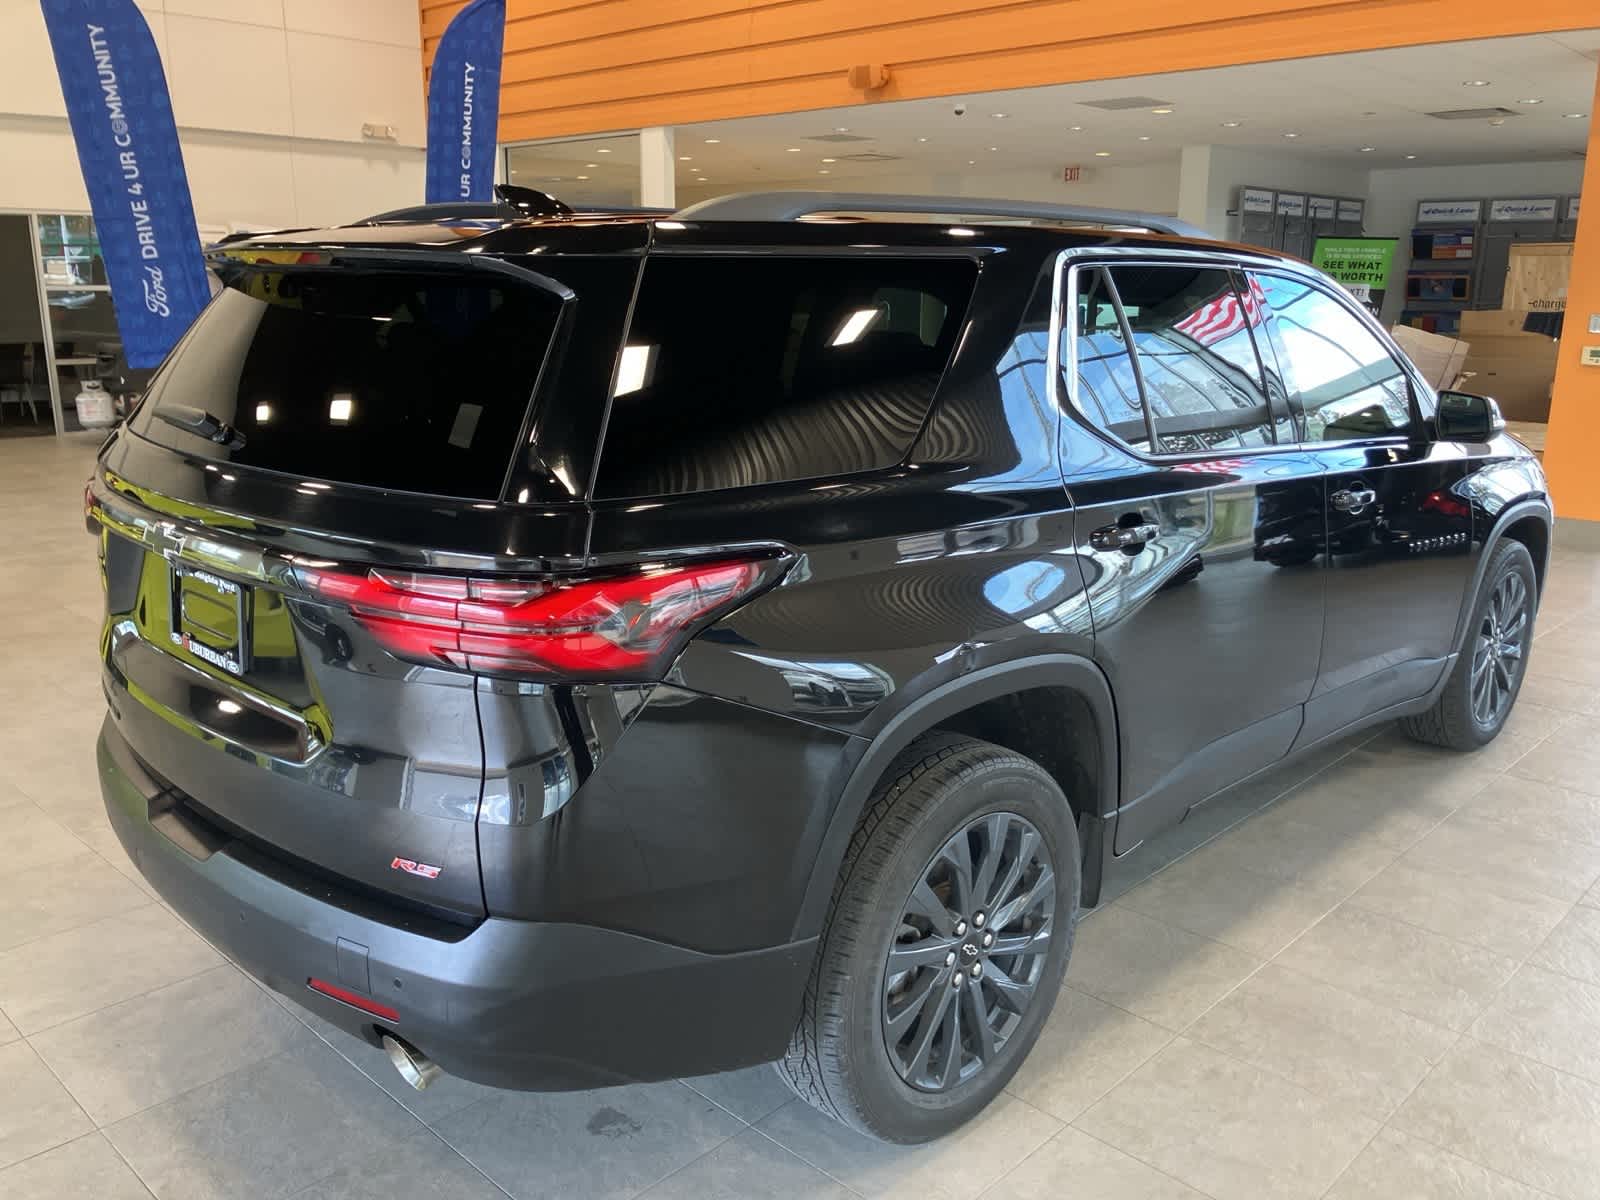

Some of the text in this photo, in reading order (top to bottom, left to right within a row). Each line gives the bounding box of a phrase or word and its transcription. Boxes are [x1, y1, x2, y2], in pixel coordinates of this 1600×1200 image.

[119, 151, 140, 180] UR
[1064, 167, 1081, 182] EXIT
[127, 182, 144, 196] 4
[460, 173, 471, 198] UR
[131, 199, 159, 259] DRIVE
[1322, 260, 1382, 270] SEE WHAT
[1341, 272, 1384, 282] WORTH
[142, 265, 170, 317] Ford
[182, 632, 227, 669] SUBURBAN
[391, 857, 441, 878] RS
